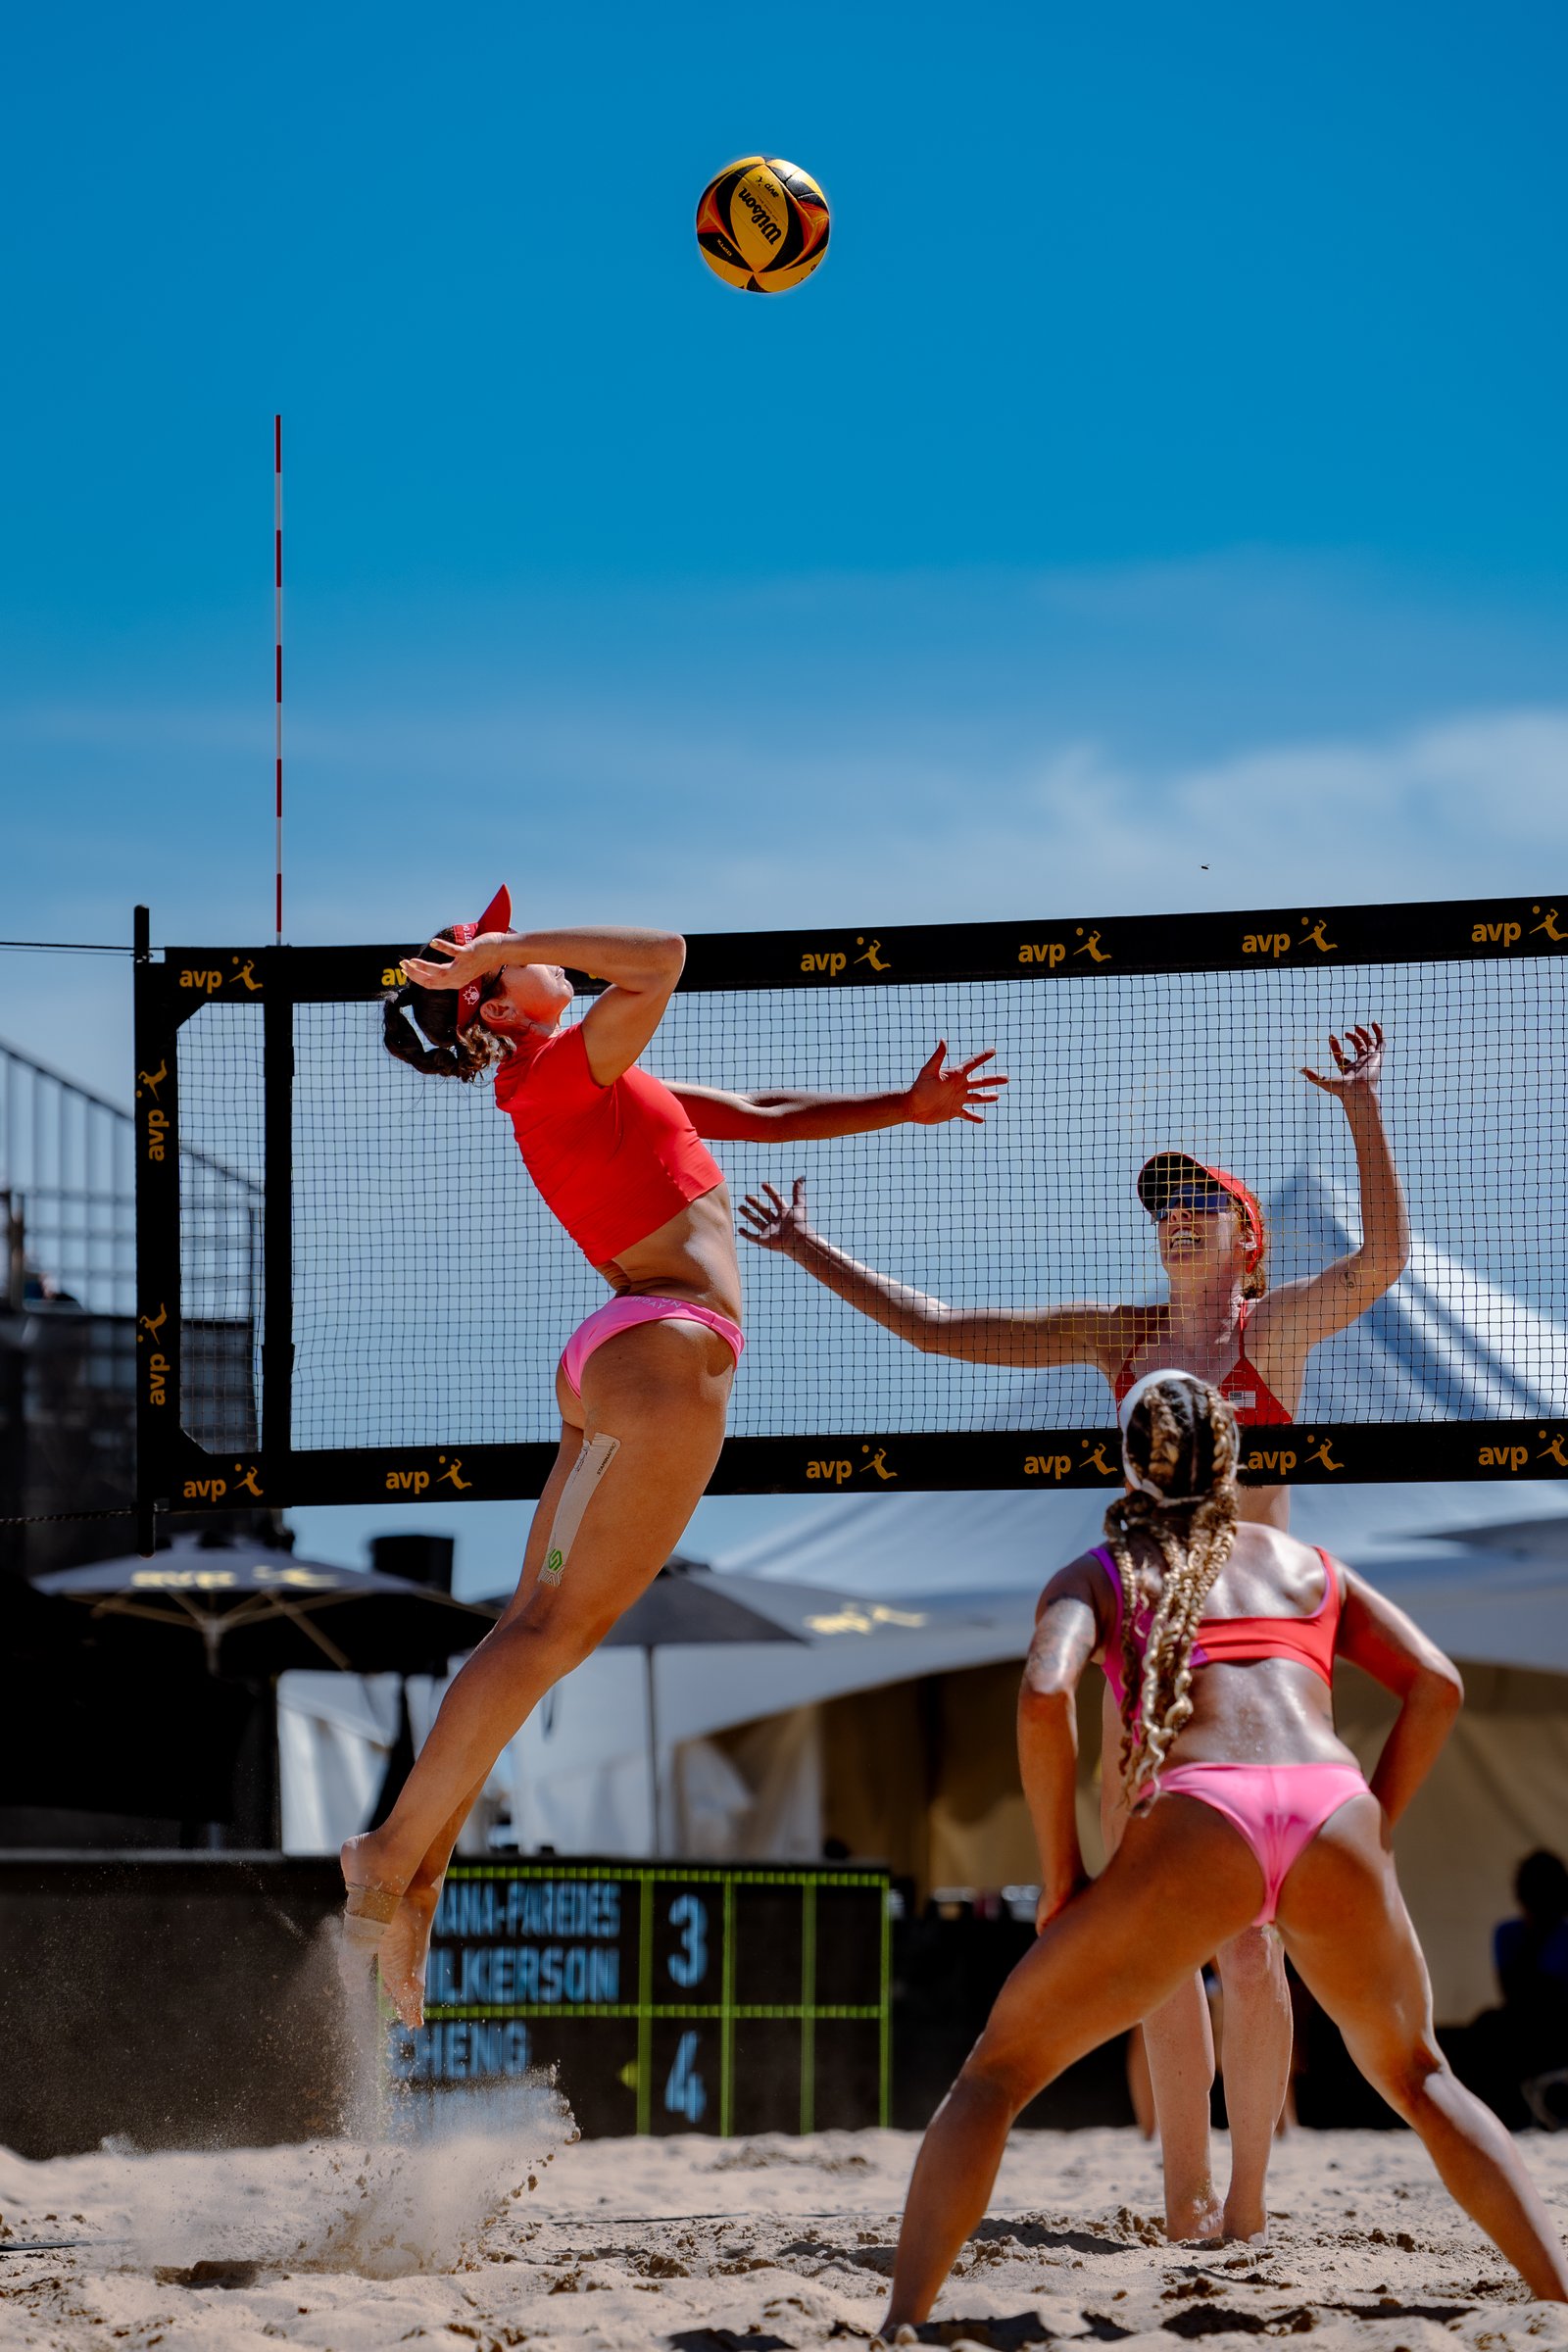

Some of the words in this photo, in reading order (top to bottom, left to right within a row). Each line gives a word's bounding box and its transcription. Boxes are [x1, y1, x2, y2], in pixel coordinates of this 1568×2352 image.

[764, 183, 780, 199] avp
[738, 186, 782, 246] Wilson
[1243, 934, 1291, 958] avp
[1472, 923, 1521, 948] avp
[801, 953, 847, 977] avp
[1019, 944, 1066, 968] avp
[179, 970, 222, 994] avp
[380, 965, 408, 987] av
[148, 1109, 170, 1161] avp
[150, 1353, 171, 1405] avp
[1024, 1455, 1072, 1480] avp
[1249, 1451, 1297, 1476] avp
[1479, 1446, 1529, 1472] avp
[385, 1471, 430, 1494] avp
[807, 1460, 853, 1485] avp
[183, 1480, 226, 1502] avp
[433, 1881, 621, 1938] ANA-PAREDES
[666, 1891, 710, 1987] 3
[425, 1946, 620, 2005] ILKERSON
[663, 2030, 708, 2125] 4
